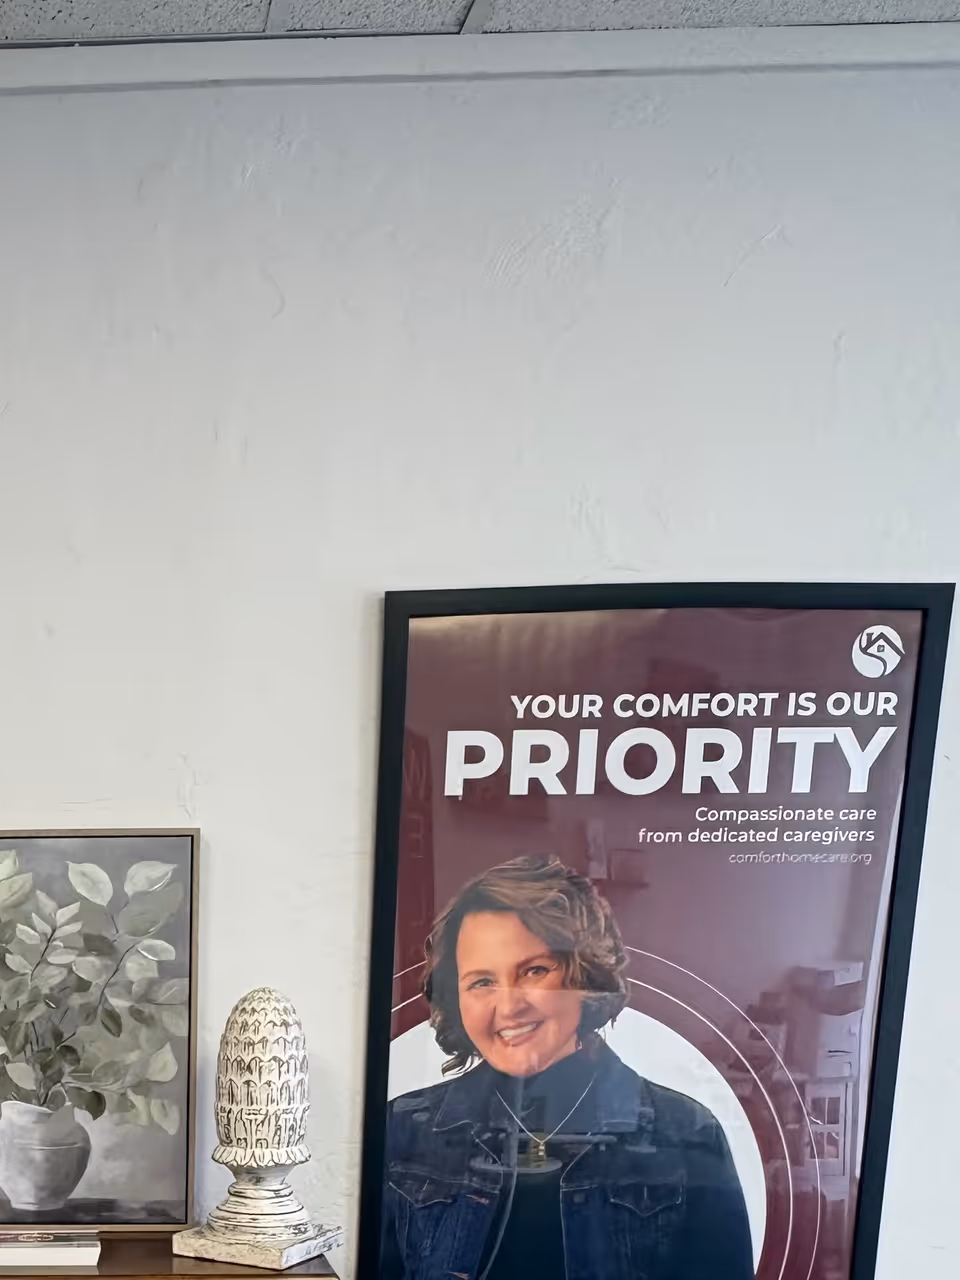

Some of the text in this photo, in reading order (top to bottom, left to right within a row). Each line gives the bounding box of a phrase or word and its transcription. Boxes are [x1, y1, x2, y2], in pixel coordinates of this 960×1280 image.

[510, 691, 899, 719] YOUR COMFORT IS OUR
[444, 726, 898, 795] PRIORITY
[695, 806, 877, 824] Compassionate care
[638, 827, 876, 845] from dedicated caregivers
[729, 851, 873, 866] comforthomecare.org
